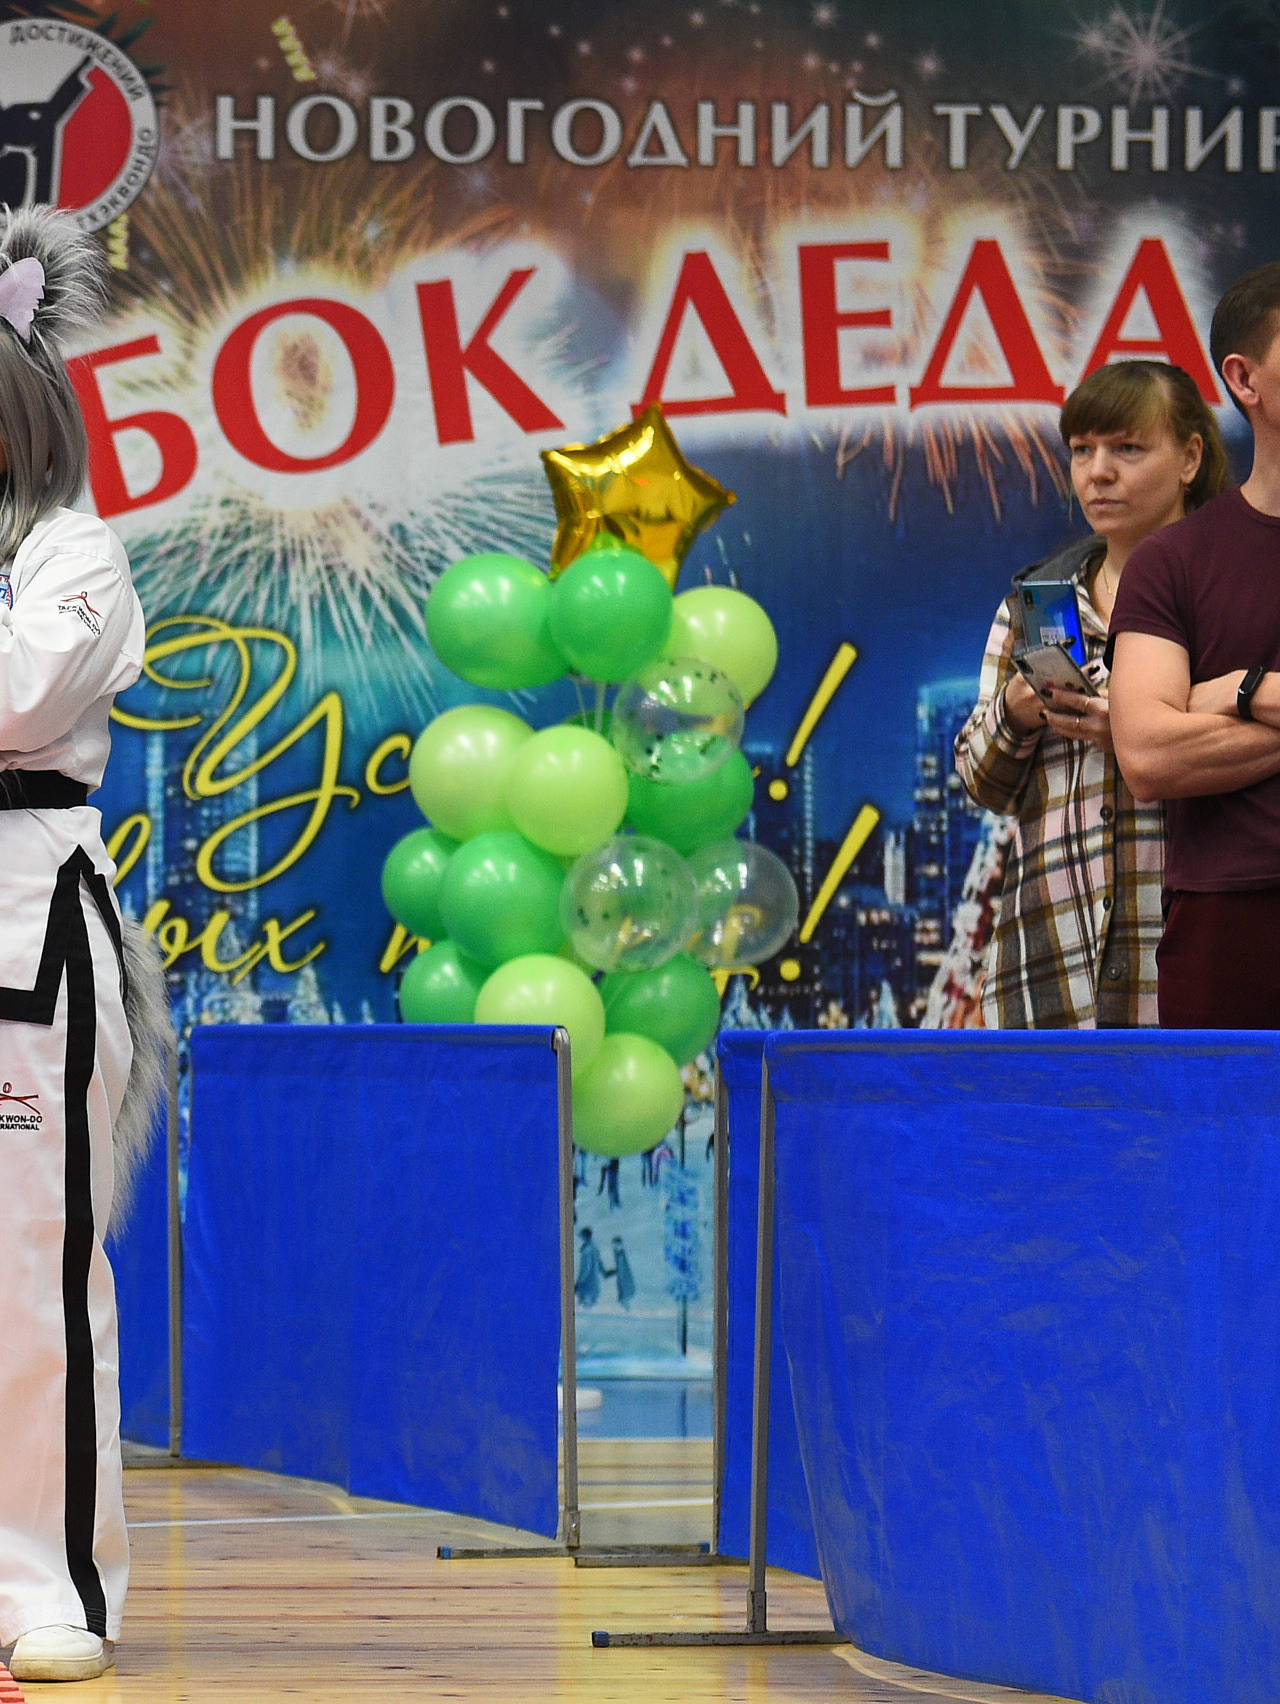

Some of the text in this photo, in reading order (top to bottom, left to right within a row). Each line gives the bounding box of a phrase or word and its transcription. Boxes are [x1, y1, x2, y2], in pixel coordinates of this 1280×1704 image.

[9, 24, 147, 101] ДОСТИЖЕНИЙ
[215, 88, 905, 170] НОВОГОДНИЙ
[630, 235, 1224, 417] ДЕДА
